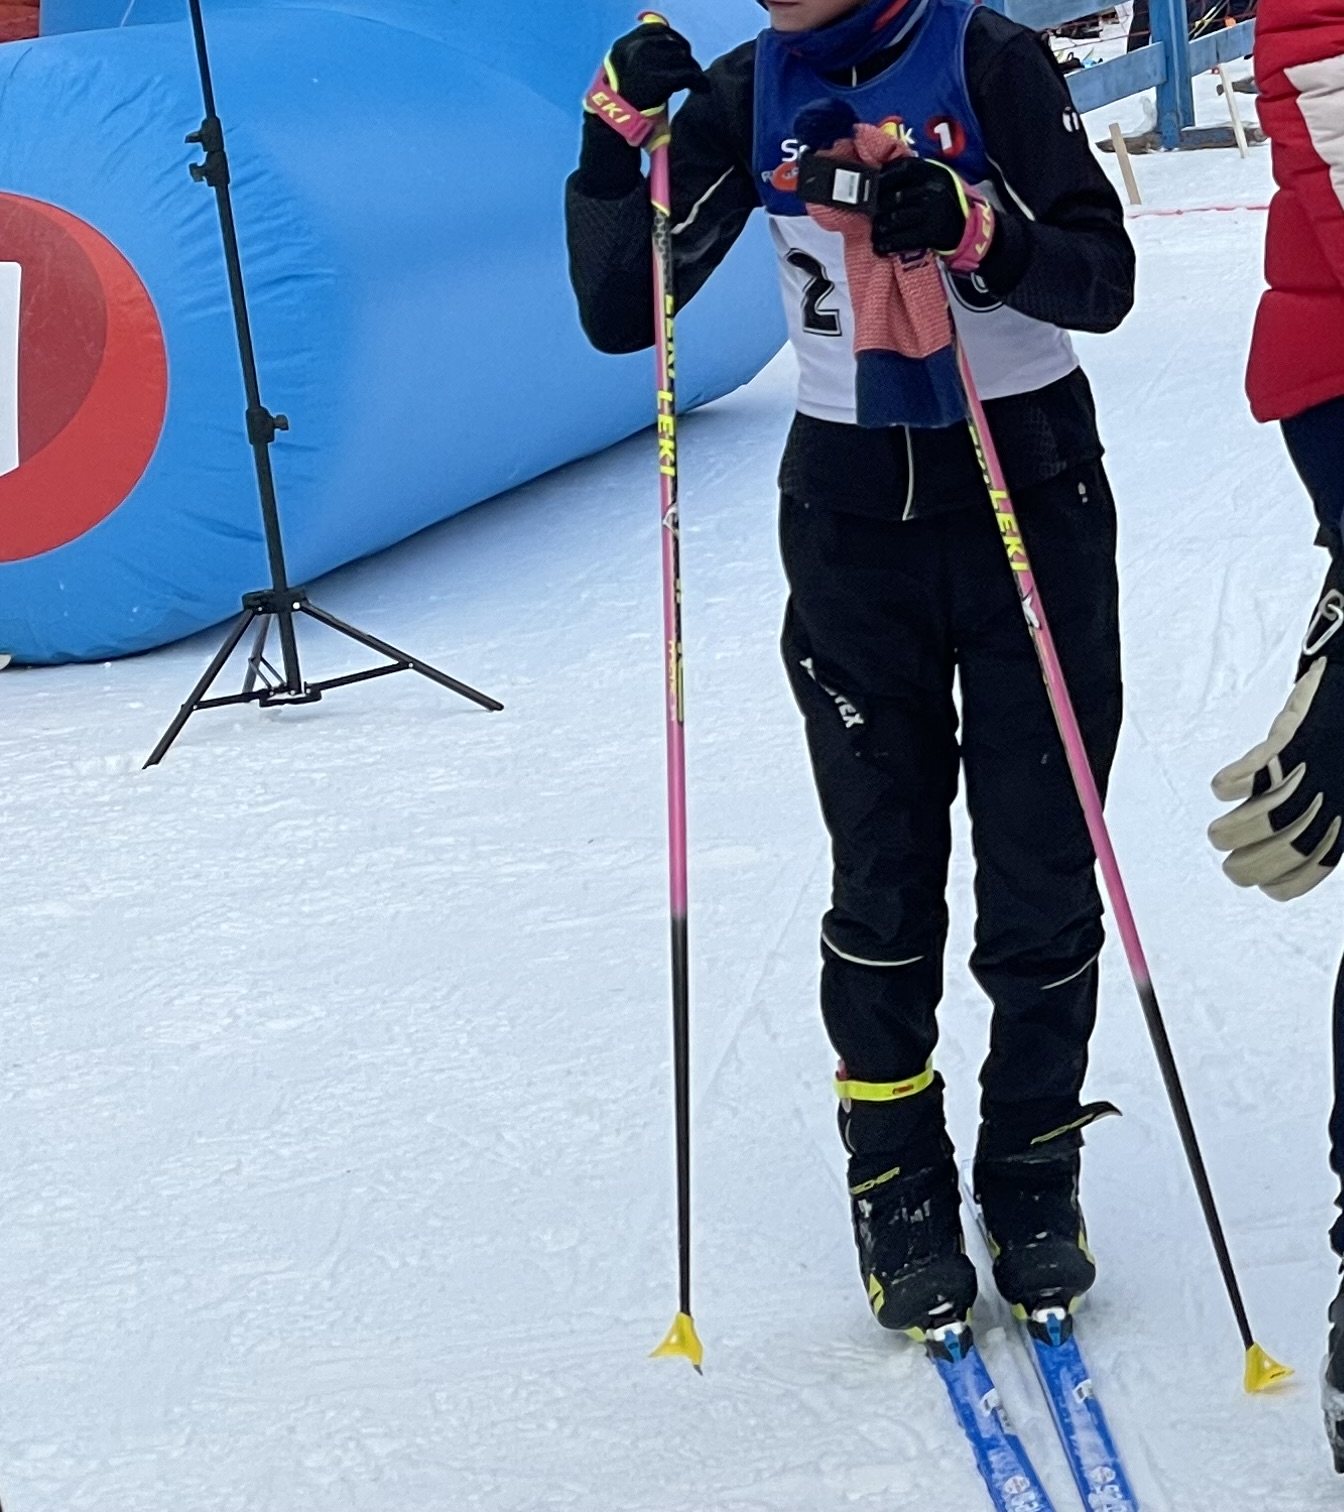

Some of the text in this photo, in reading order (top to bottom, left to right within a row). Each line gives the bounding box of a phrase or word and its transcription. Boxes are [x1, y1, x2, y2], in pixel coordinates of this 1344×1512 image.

[591, 91, 631, 123] EKI
[657, 390, 676, 477] LEKI
[989, 490, 1030, 571] LEKI
